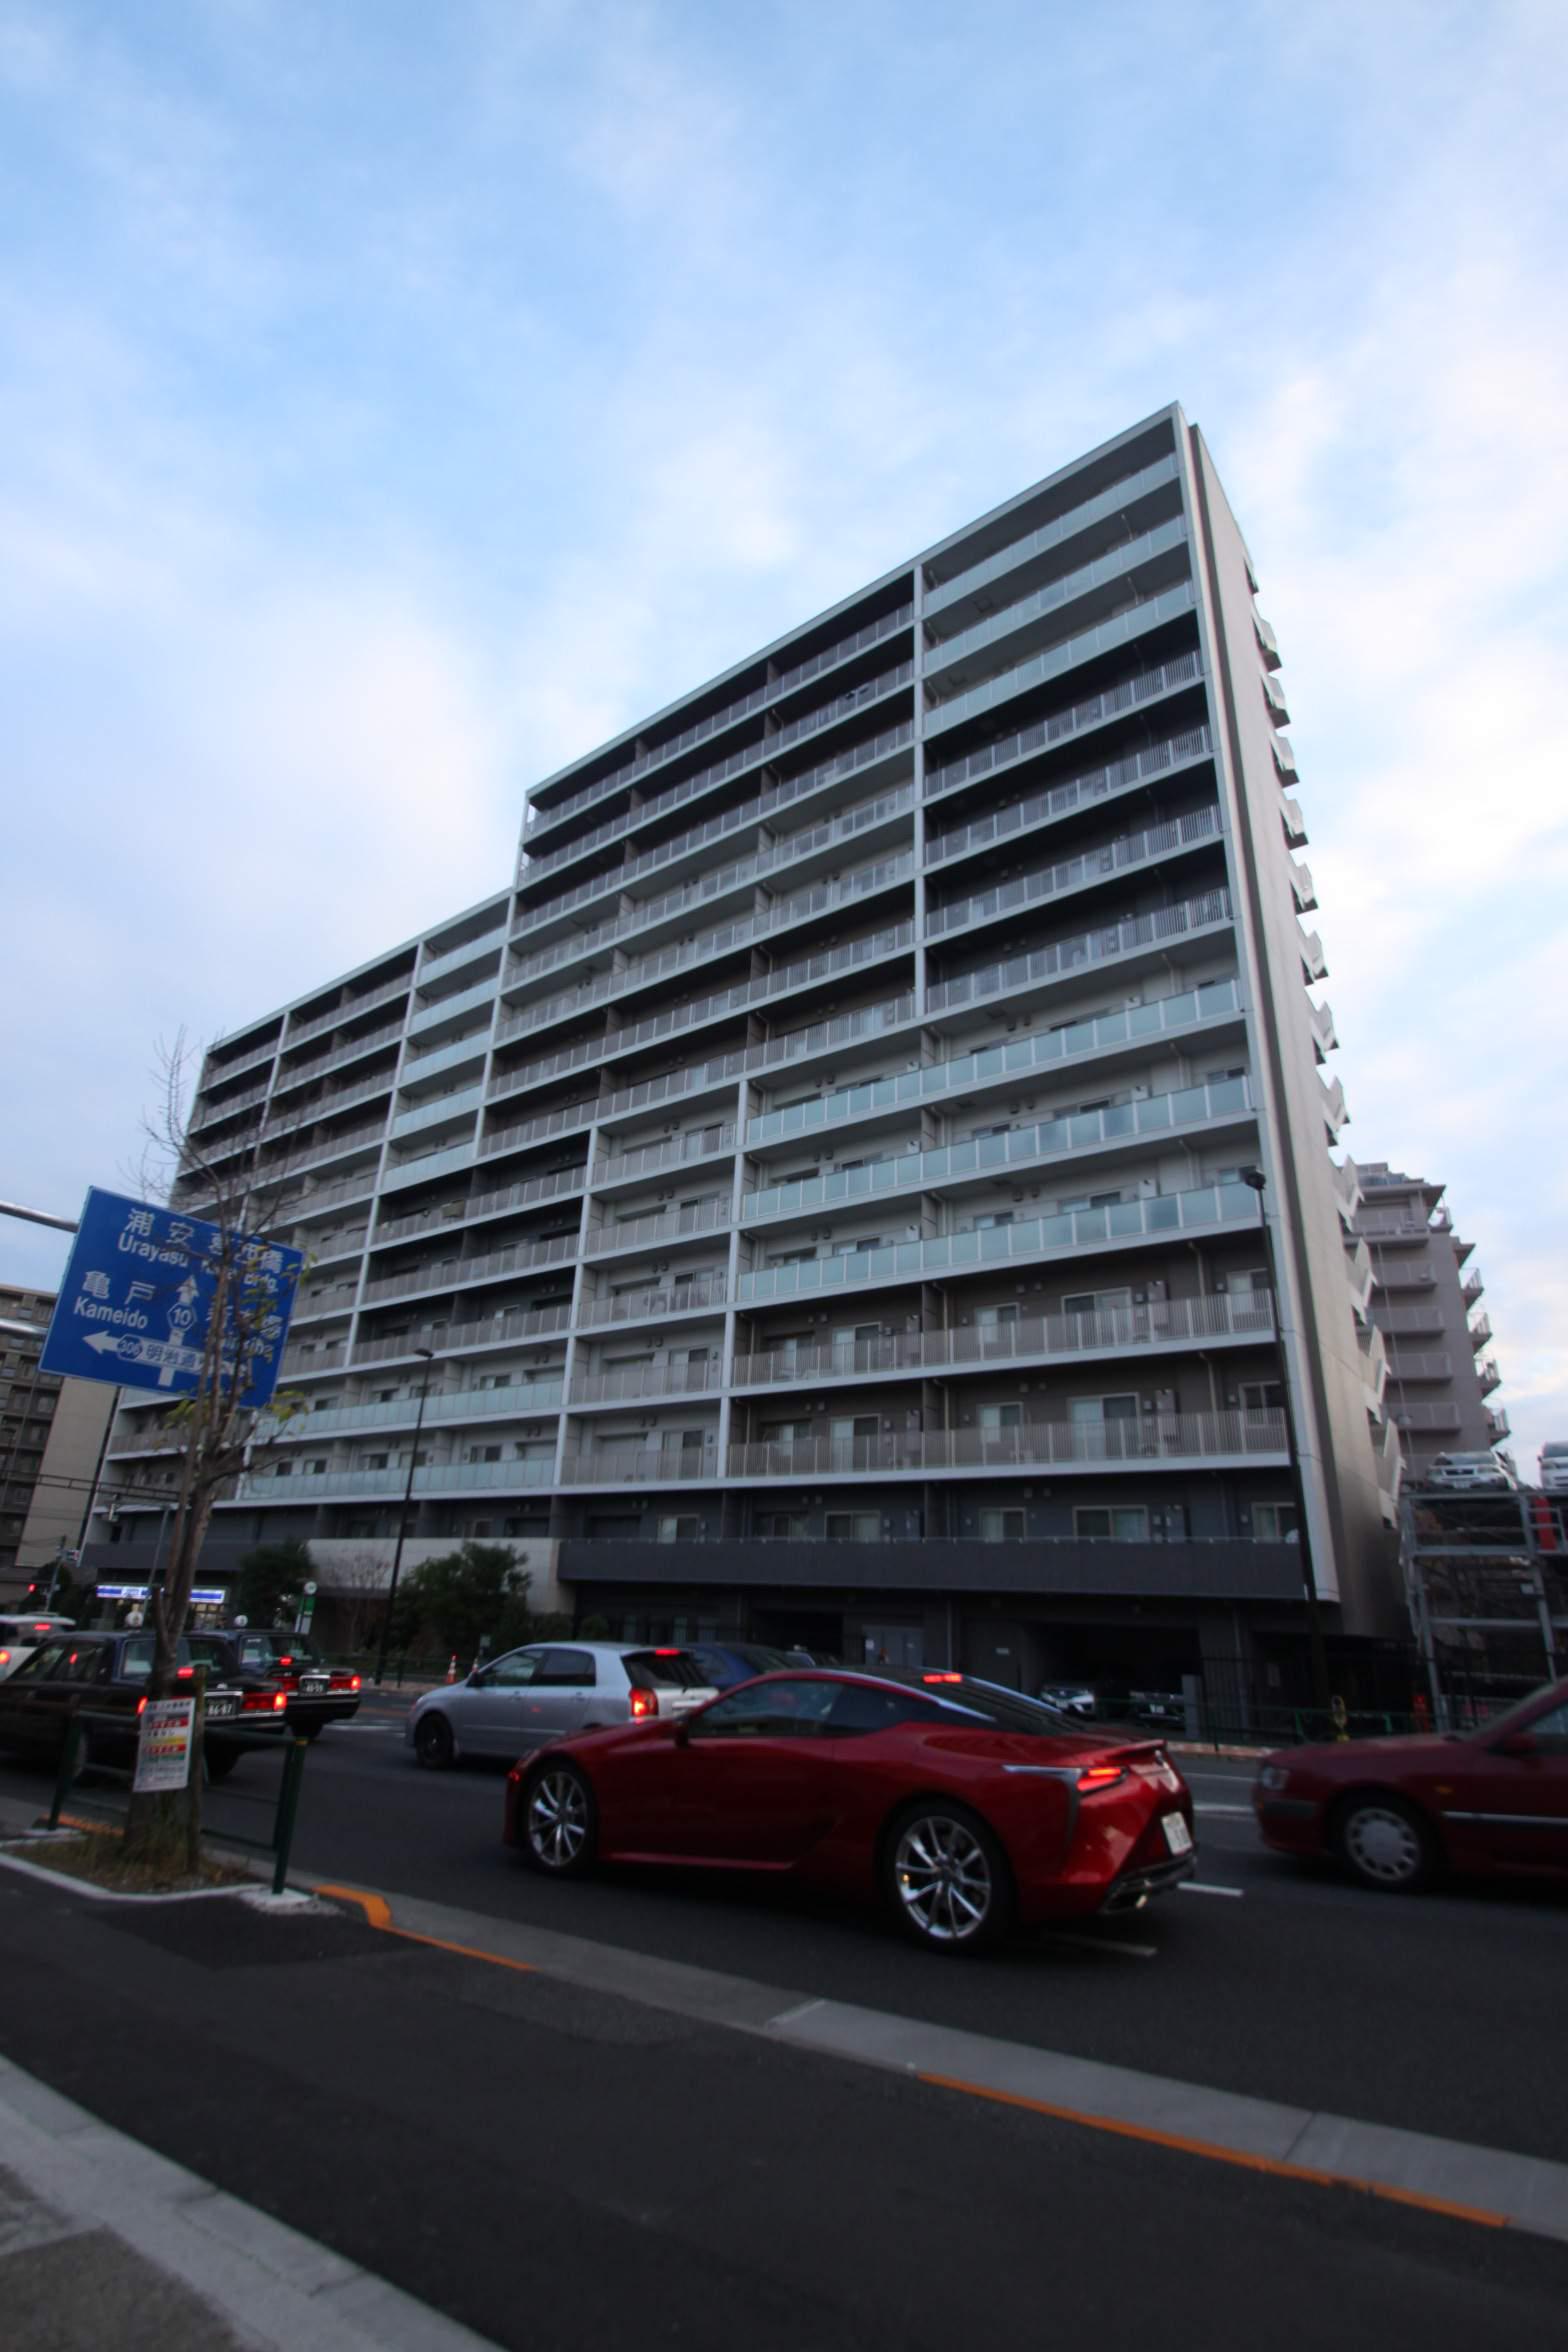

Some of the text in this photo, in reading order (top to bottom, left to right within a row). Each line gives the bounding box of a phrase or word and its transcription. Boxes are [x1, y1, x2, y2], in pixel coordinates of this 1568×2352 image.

[124, 1208, 195, 1249] 浦安
[117, 1233, 190, 1268] Urayasu
[83, 1270, 156, 1306] 亀戸
[73, 1295, 149, 1330] Kameido
[174, 1308, 191, 1326] 10
